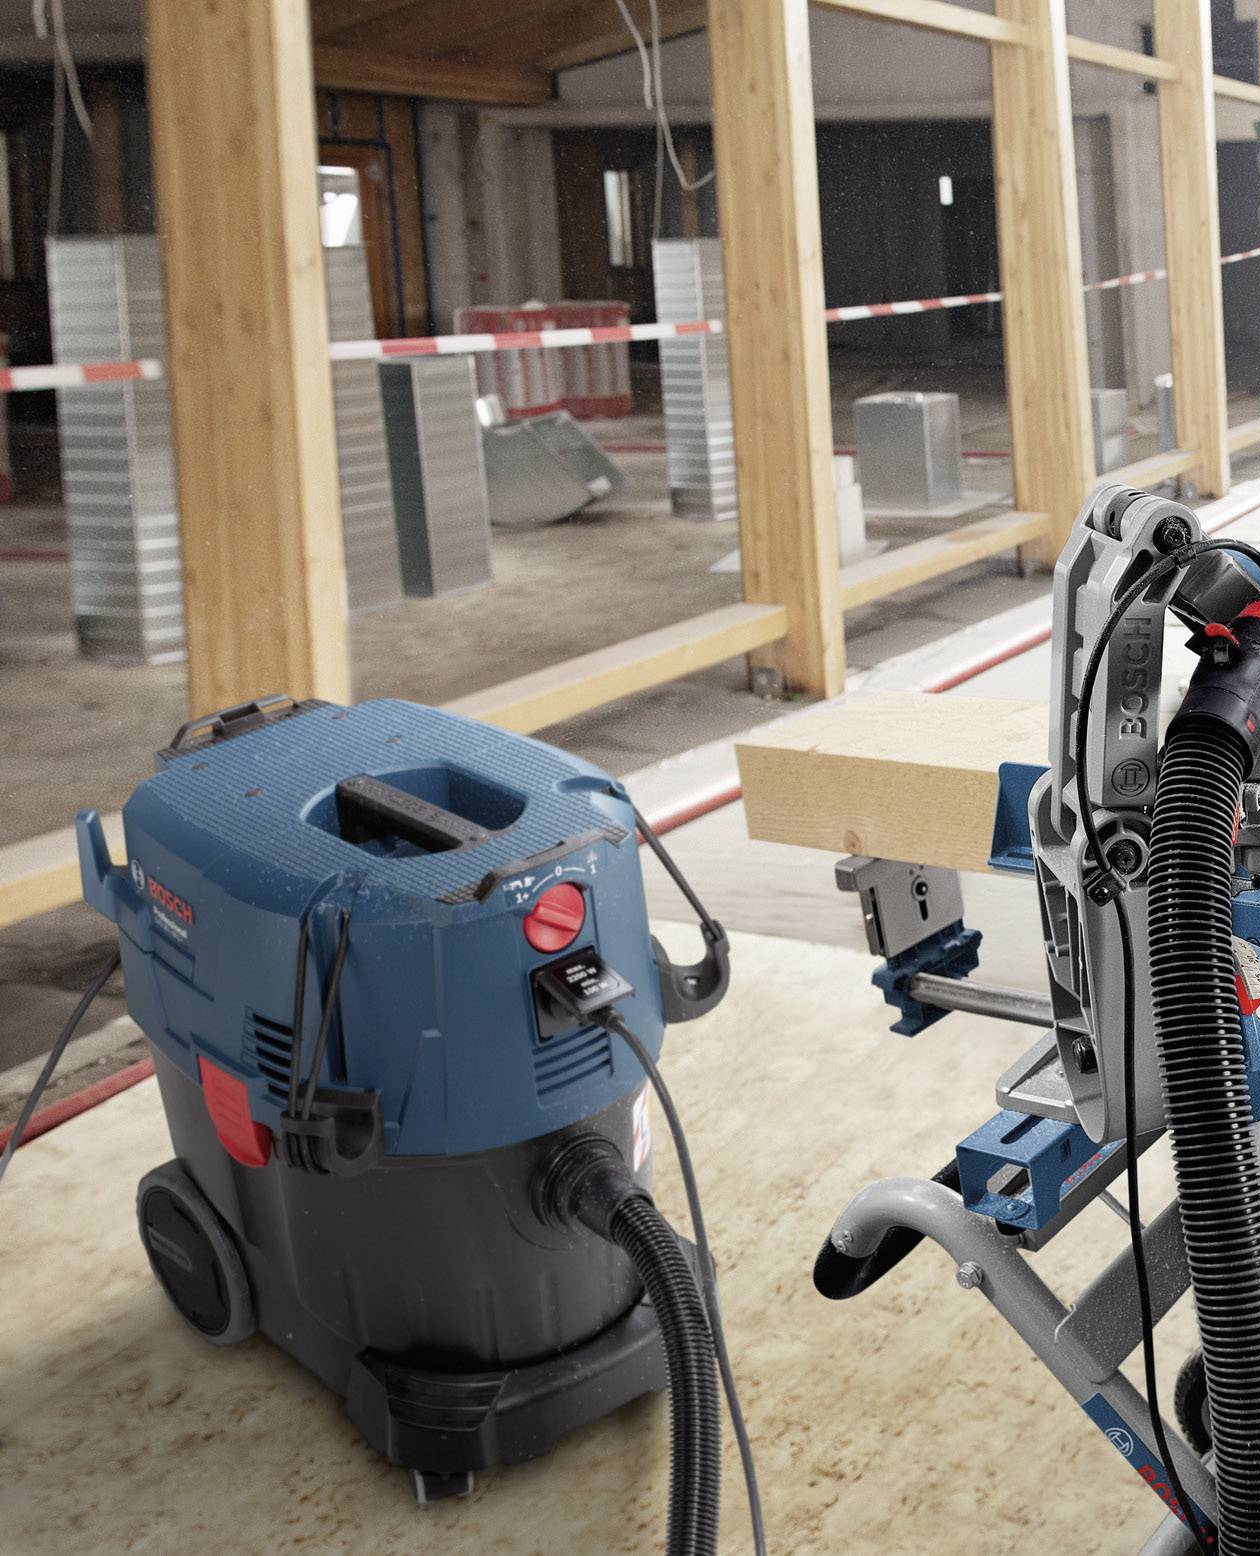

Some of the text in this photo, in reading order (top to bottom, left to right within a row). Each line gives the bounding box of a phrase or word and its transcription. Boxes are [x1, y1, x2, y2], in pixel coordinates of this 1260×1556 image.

[1119, 617, 1152, 740] BOSCH
[554, 865, 563, 877] 0
[590, 864, 597, 875] 1
[149, 877, 193, 925] BOSCH
